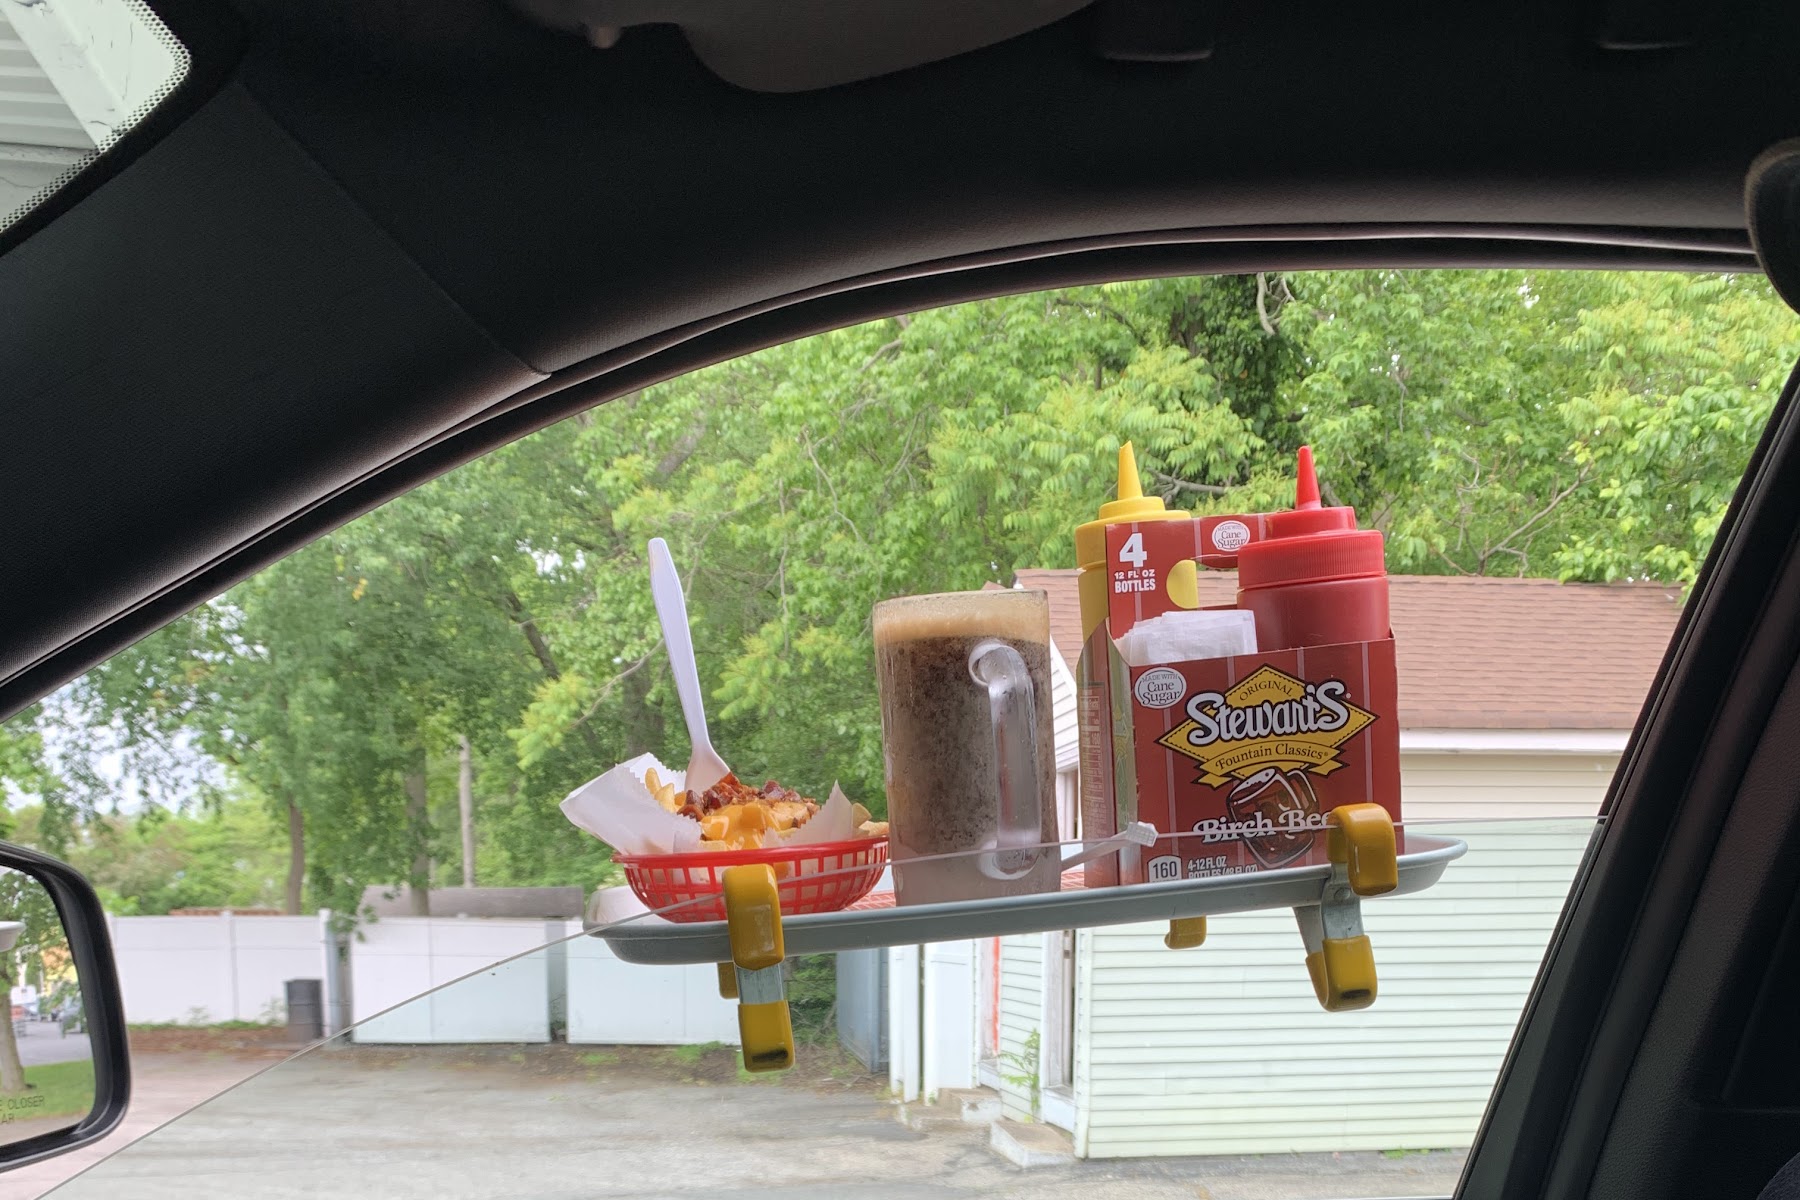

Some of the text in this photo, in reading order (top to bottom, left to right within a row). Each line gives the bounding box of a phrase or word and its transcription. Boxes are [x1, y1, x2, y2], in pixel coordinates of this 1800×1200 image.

[1221, 530, 1241, 540] Cane
[1119, 532, 1147, 568] 4
[1217, 539, 1246, 548] Sugar
[1114, 569, 1155, 580] 12 FL OZ
[1114, 578, 1156, 594] BOTTLES
[1142, 673, 1161, 682] MADE
[1147, 681, 1175, 693] Cane
[1239, 680, 1294, 701] ORIGINAL
[1142, 690, 1180, 705] Sugar
[1215, 746, 1272, 771] Fountain
[1192, 809, 1331, 843] Birch Bee
[1152, 861, 1177, 879] 160
[7, 1095, 45, 1110] CLOSER
